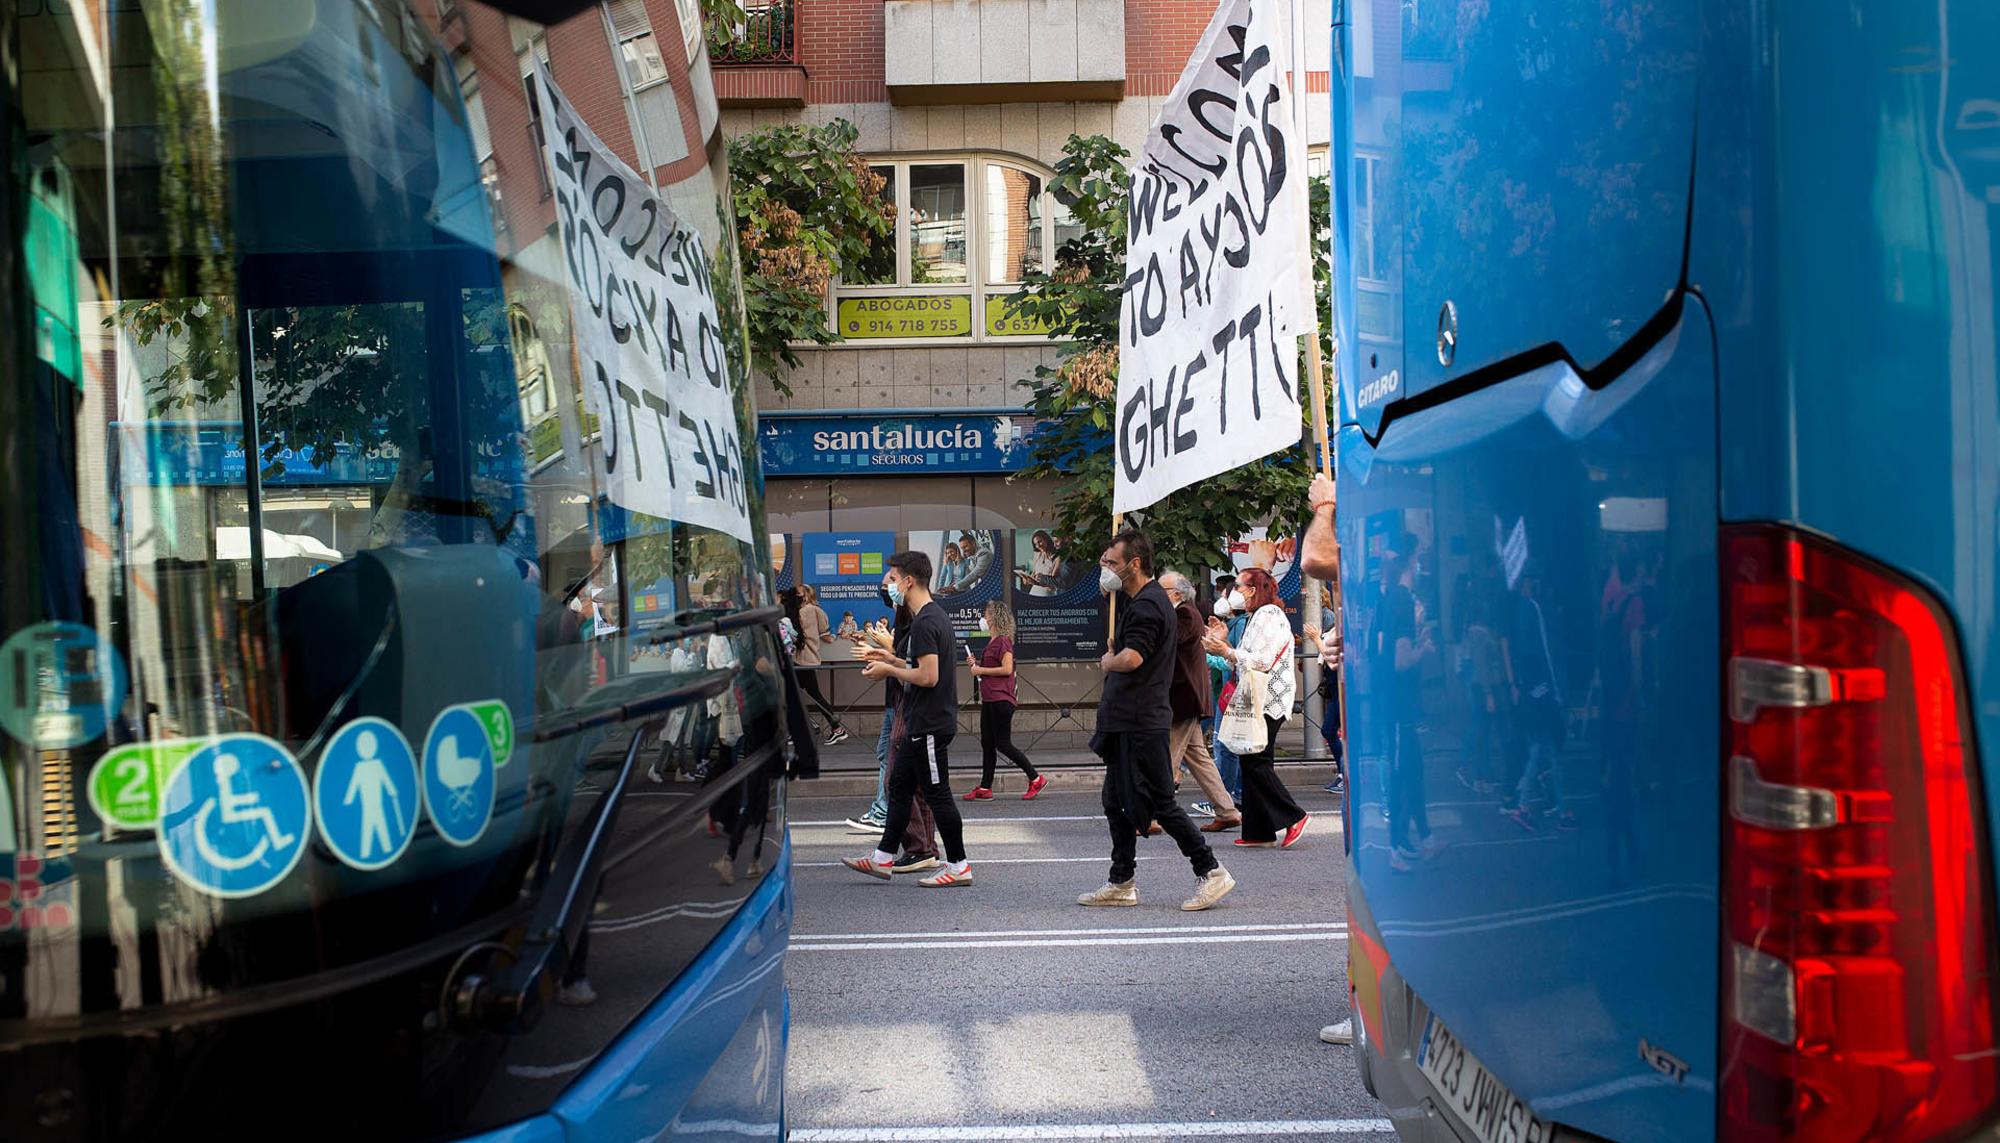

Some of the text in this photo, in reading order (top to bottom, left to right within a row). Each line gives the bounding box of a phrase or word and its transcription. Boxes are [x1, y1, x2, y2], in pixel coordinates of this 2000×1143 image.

[856, 299, 953, 311] ABOGADOS
[1122, 251, 1168, 349] TO
[869, 319, 958, 332] 914 718 755
[1358, 369, 1399, 409] CITARO
[813, 424, 982, 450] santalucía
[871, 454, 924, 466] SEGUROS
[1017, 609, 1028, 617] HAZ
[1028, 609, 1050, 617] CRECER
[1060, 608, 1087, 616] AHORROS
[1086, 608, 1099, 616] CON
[1024, 617, 1043, 625] MEJOR
[491, 710, 507, 747] 3
[113, 758, 150, 804] 2
[1427, 1021, 1465, 1097] 4723
[1638, 1038, 1691, 1084] NGT
